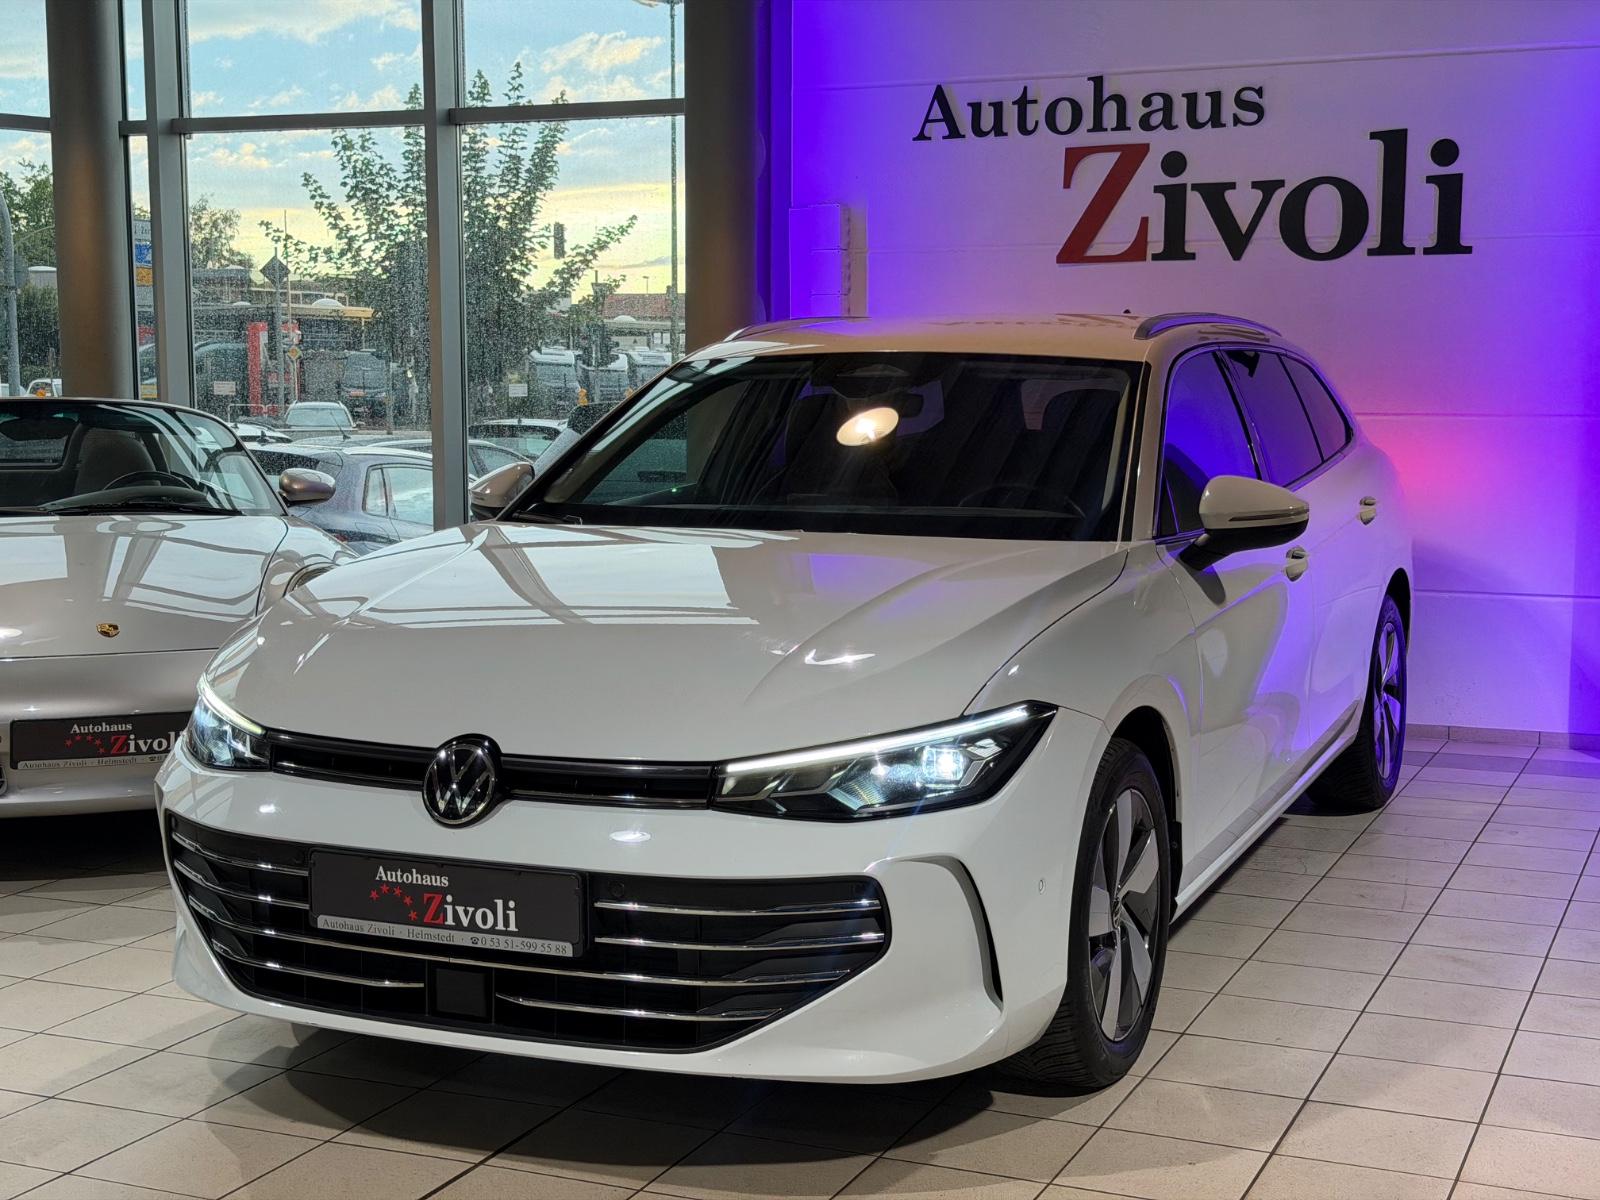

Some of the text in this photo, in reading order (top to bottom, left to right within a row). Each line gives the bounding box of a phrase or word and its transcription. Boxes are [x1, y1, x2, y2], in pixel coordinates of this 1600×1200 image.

[912, 75, 1266, 141] Autohaus
[1056, 128, 1473, 264] Zivoli
[70, 722, 133, 734] Autohaus
[109, 730, 184, 755] Zivol
[375, 865, 449, 888] Autohaus
[423, 892, 519, 932] Zivoli
[322, 918, 364, 933] Autohaus
[367, 923, 395, 936] Zivoli
[407, 928, 455, 944] Helmstedt
